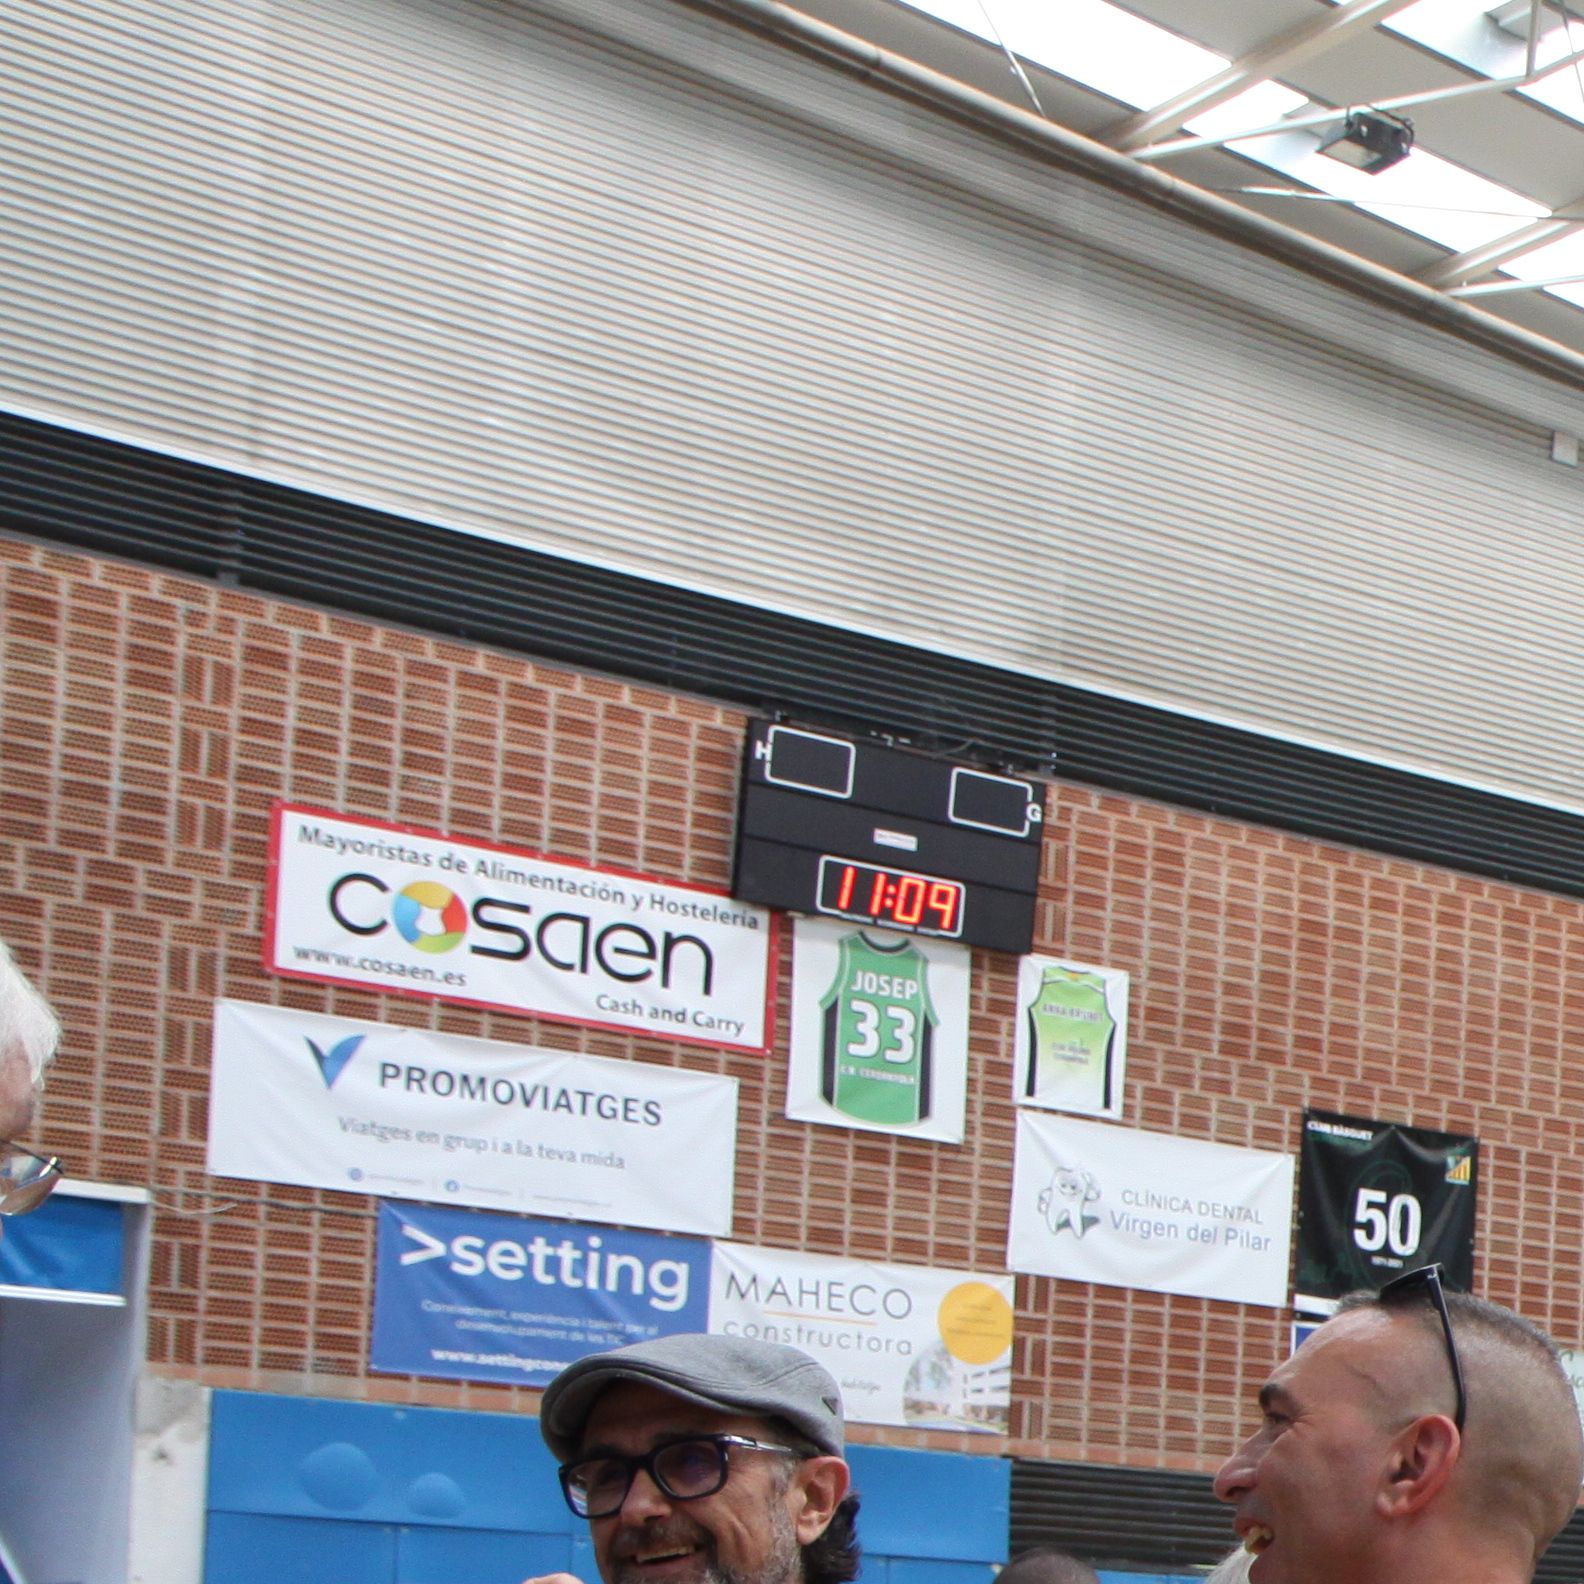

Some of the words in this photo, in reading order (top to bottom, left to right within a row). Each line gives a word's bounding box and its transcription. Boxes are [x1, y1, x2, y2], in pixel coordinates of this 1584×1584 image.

[298, 825, 431, 868] Mayoristas
[439, 851, 467, 874] de
[477, 858, 625, 905] Alimentación
[631, 893, 645, 912] y
[650, 892, 759, 930] Hostelería
[838, 866, 958, 929] 11:09
[293, 944, 466, 988] www.cosaen.es
[851, 969, 918, 1000] JOSEP
[595, 994, 641, 1018] Cash
[648, 1002, 686, 1024] and
[691, 1009, 745, 1037] Carry
[847, 999, 917, 1064] 33
[379, 1061, 663, 1126] PROMOVIATGES
[338, 1117, 411, 1143] Viatges
[415, 1129, 440, 1144] en
[444, 1132, 487, 1154] grup
[491, 1134, 499, 1149] i
[502, 1140, 515, 1153] a
[516, 1137, 534, 1155] la
[538, 1142, 577, 1164] teva
[581, 1149, 626, 1169] mida
[1110, 1210, 1179, 1242] Virgen
[1188, 1224, 1218, 1244] del
[1224, 1229, 1271, 1252] Pilar
[1121, 1188, 1192, 1214] CLÍNICA
[1198, 1201, 1263, 1225] DENTAL
[1353, 1188, 1421, 1257] 50
[725, 1271, 912, 1320] MAHECO
[723, 1319, 912, 1356] constructora
